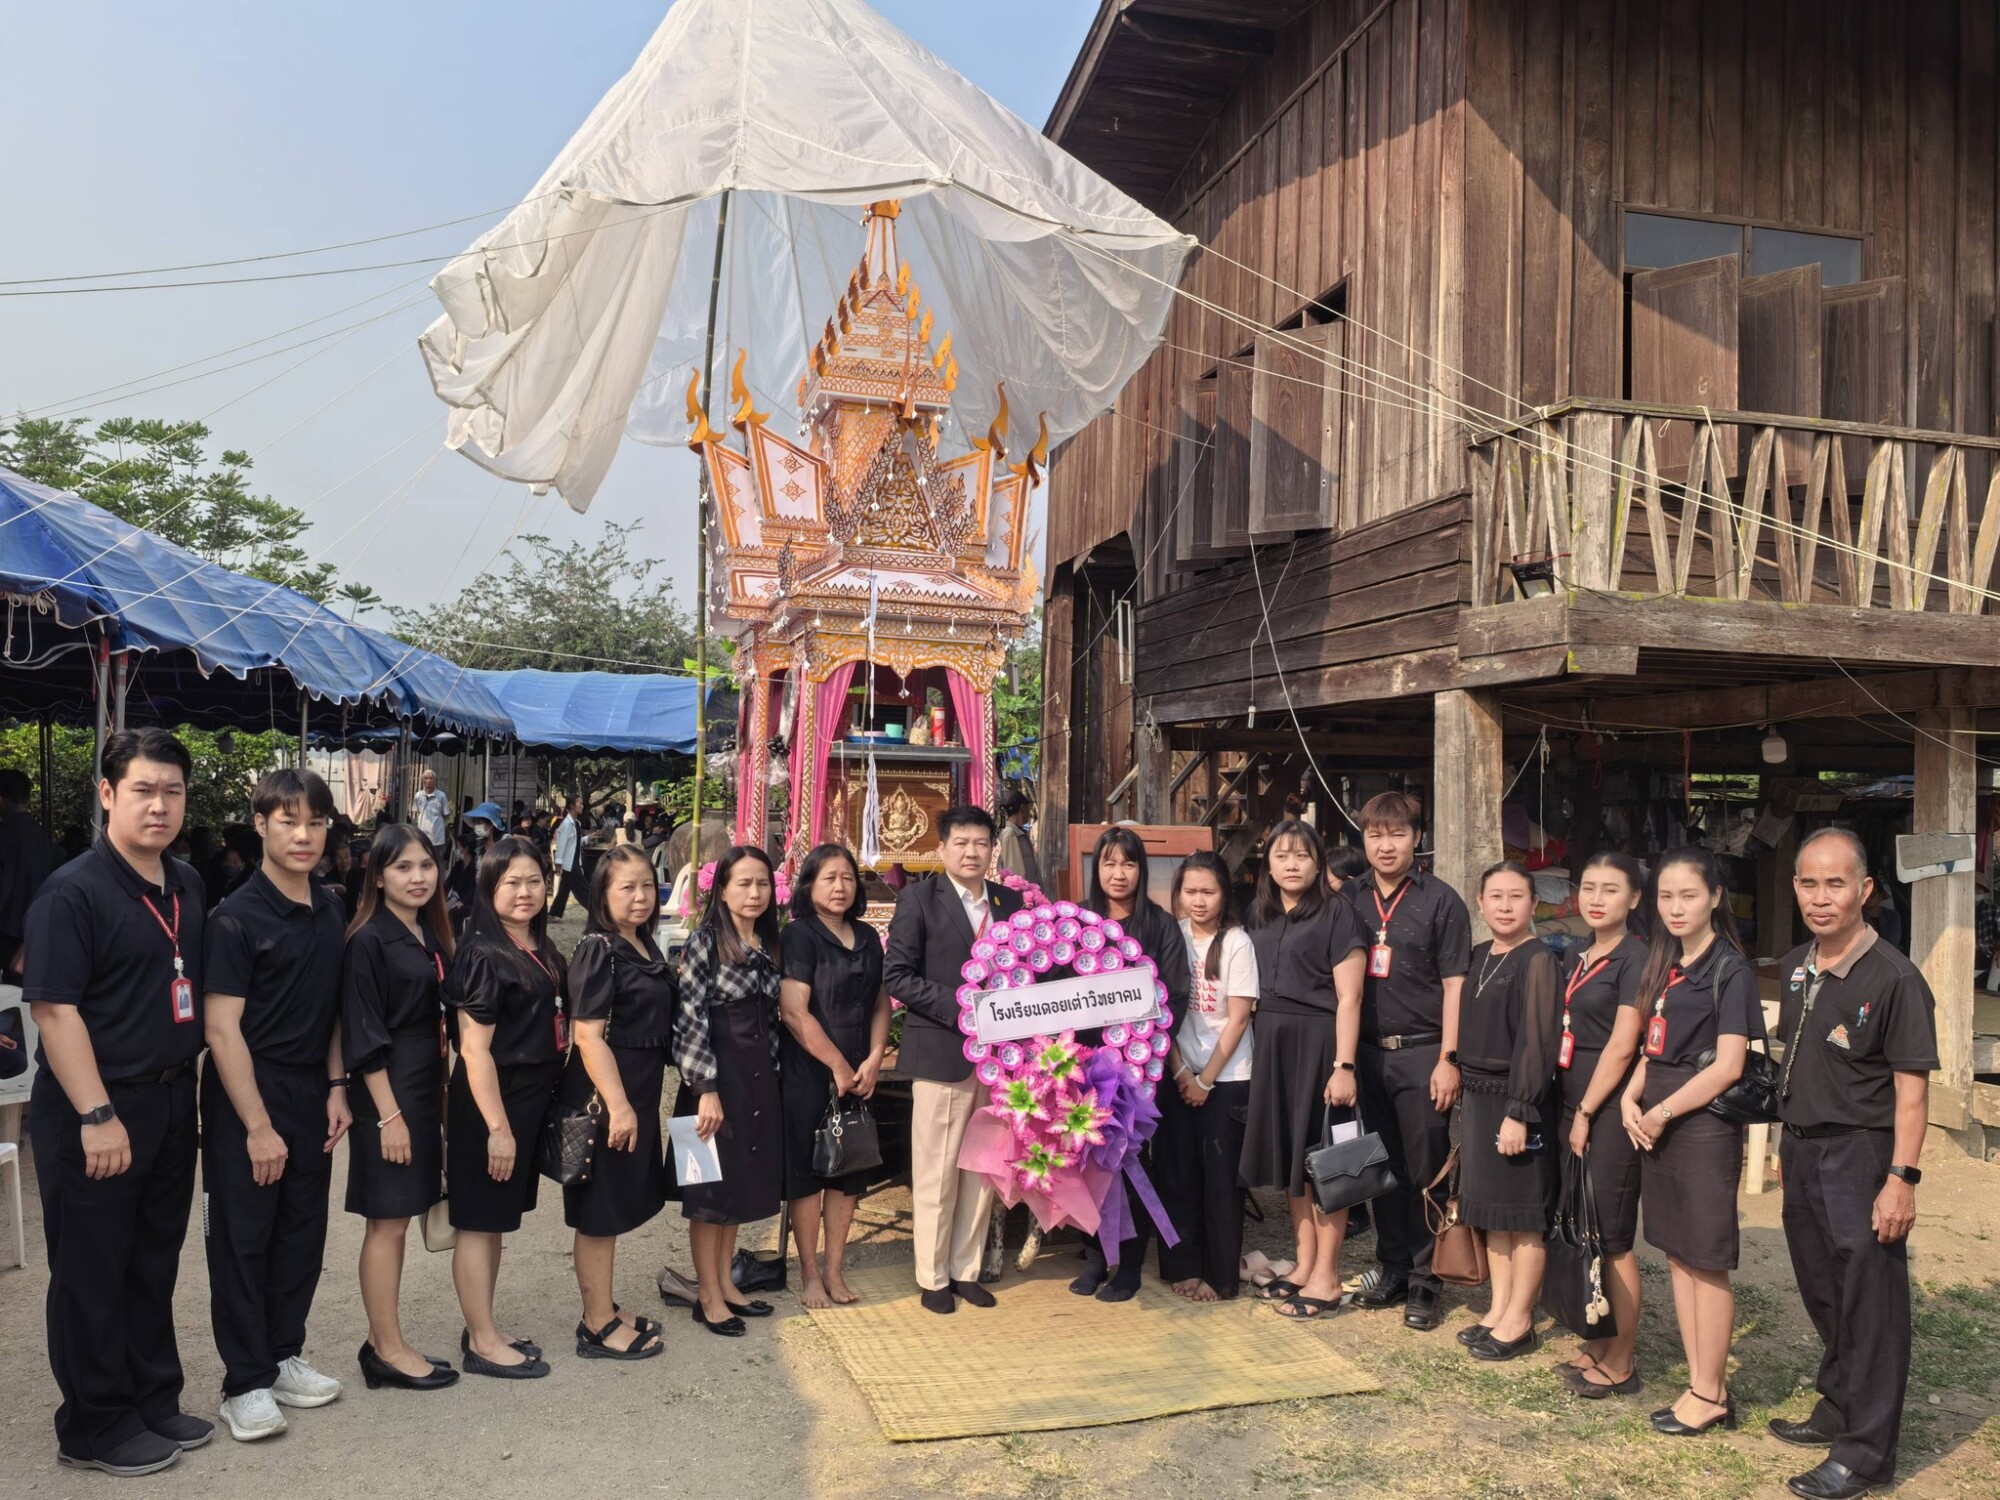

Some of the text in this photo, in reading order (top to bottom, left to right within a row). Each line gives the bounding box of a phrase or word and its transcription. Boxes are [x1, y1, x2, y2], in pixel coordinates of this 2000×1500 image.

[989, 987, 1143, 1022] โรงเรียนดอยเต่าวิทยาคม
